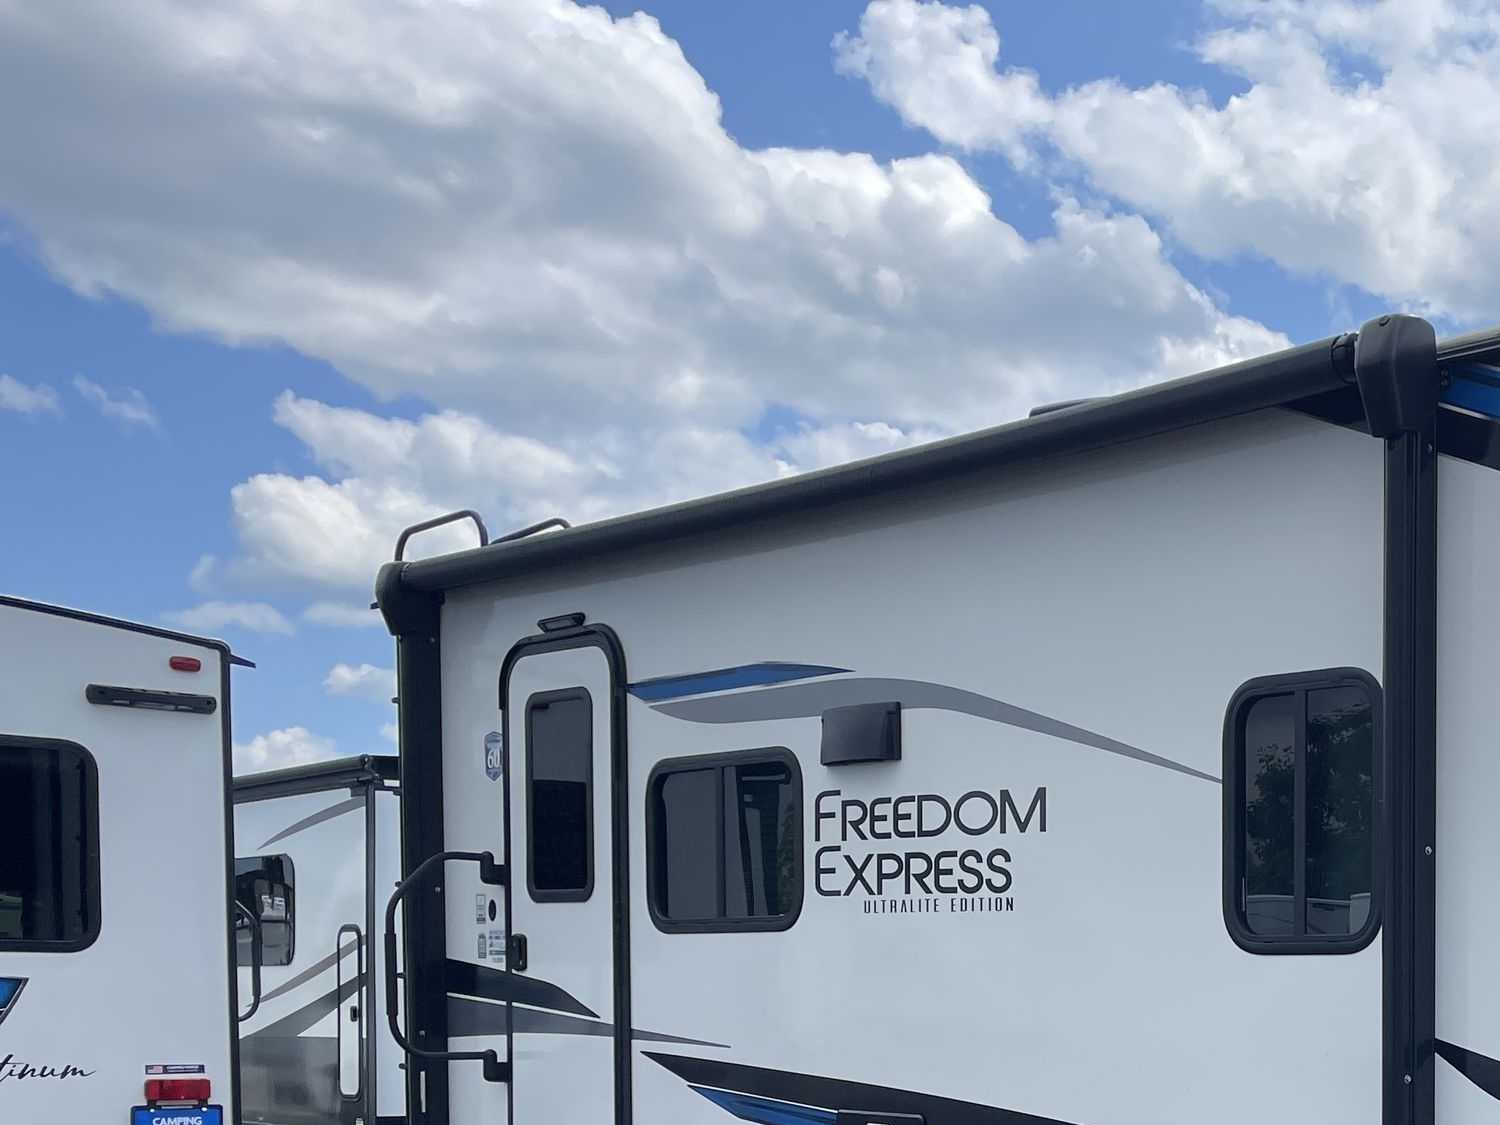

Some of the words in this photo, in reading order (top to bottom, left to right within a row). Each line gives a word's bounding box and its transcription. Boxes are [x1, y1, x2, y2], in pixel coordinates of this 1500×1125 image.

[815, 787, 1047, 842] FREEDOM
[815, 846, 1013, 897] EXPRESS
[864, 899, 940, 914] ULTRALITE
[950, 896, 1014, 913] EDITION
[0, 1054, 96, 1083] tinum
